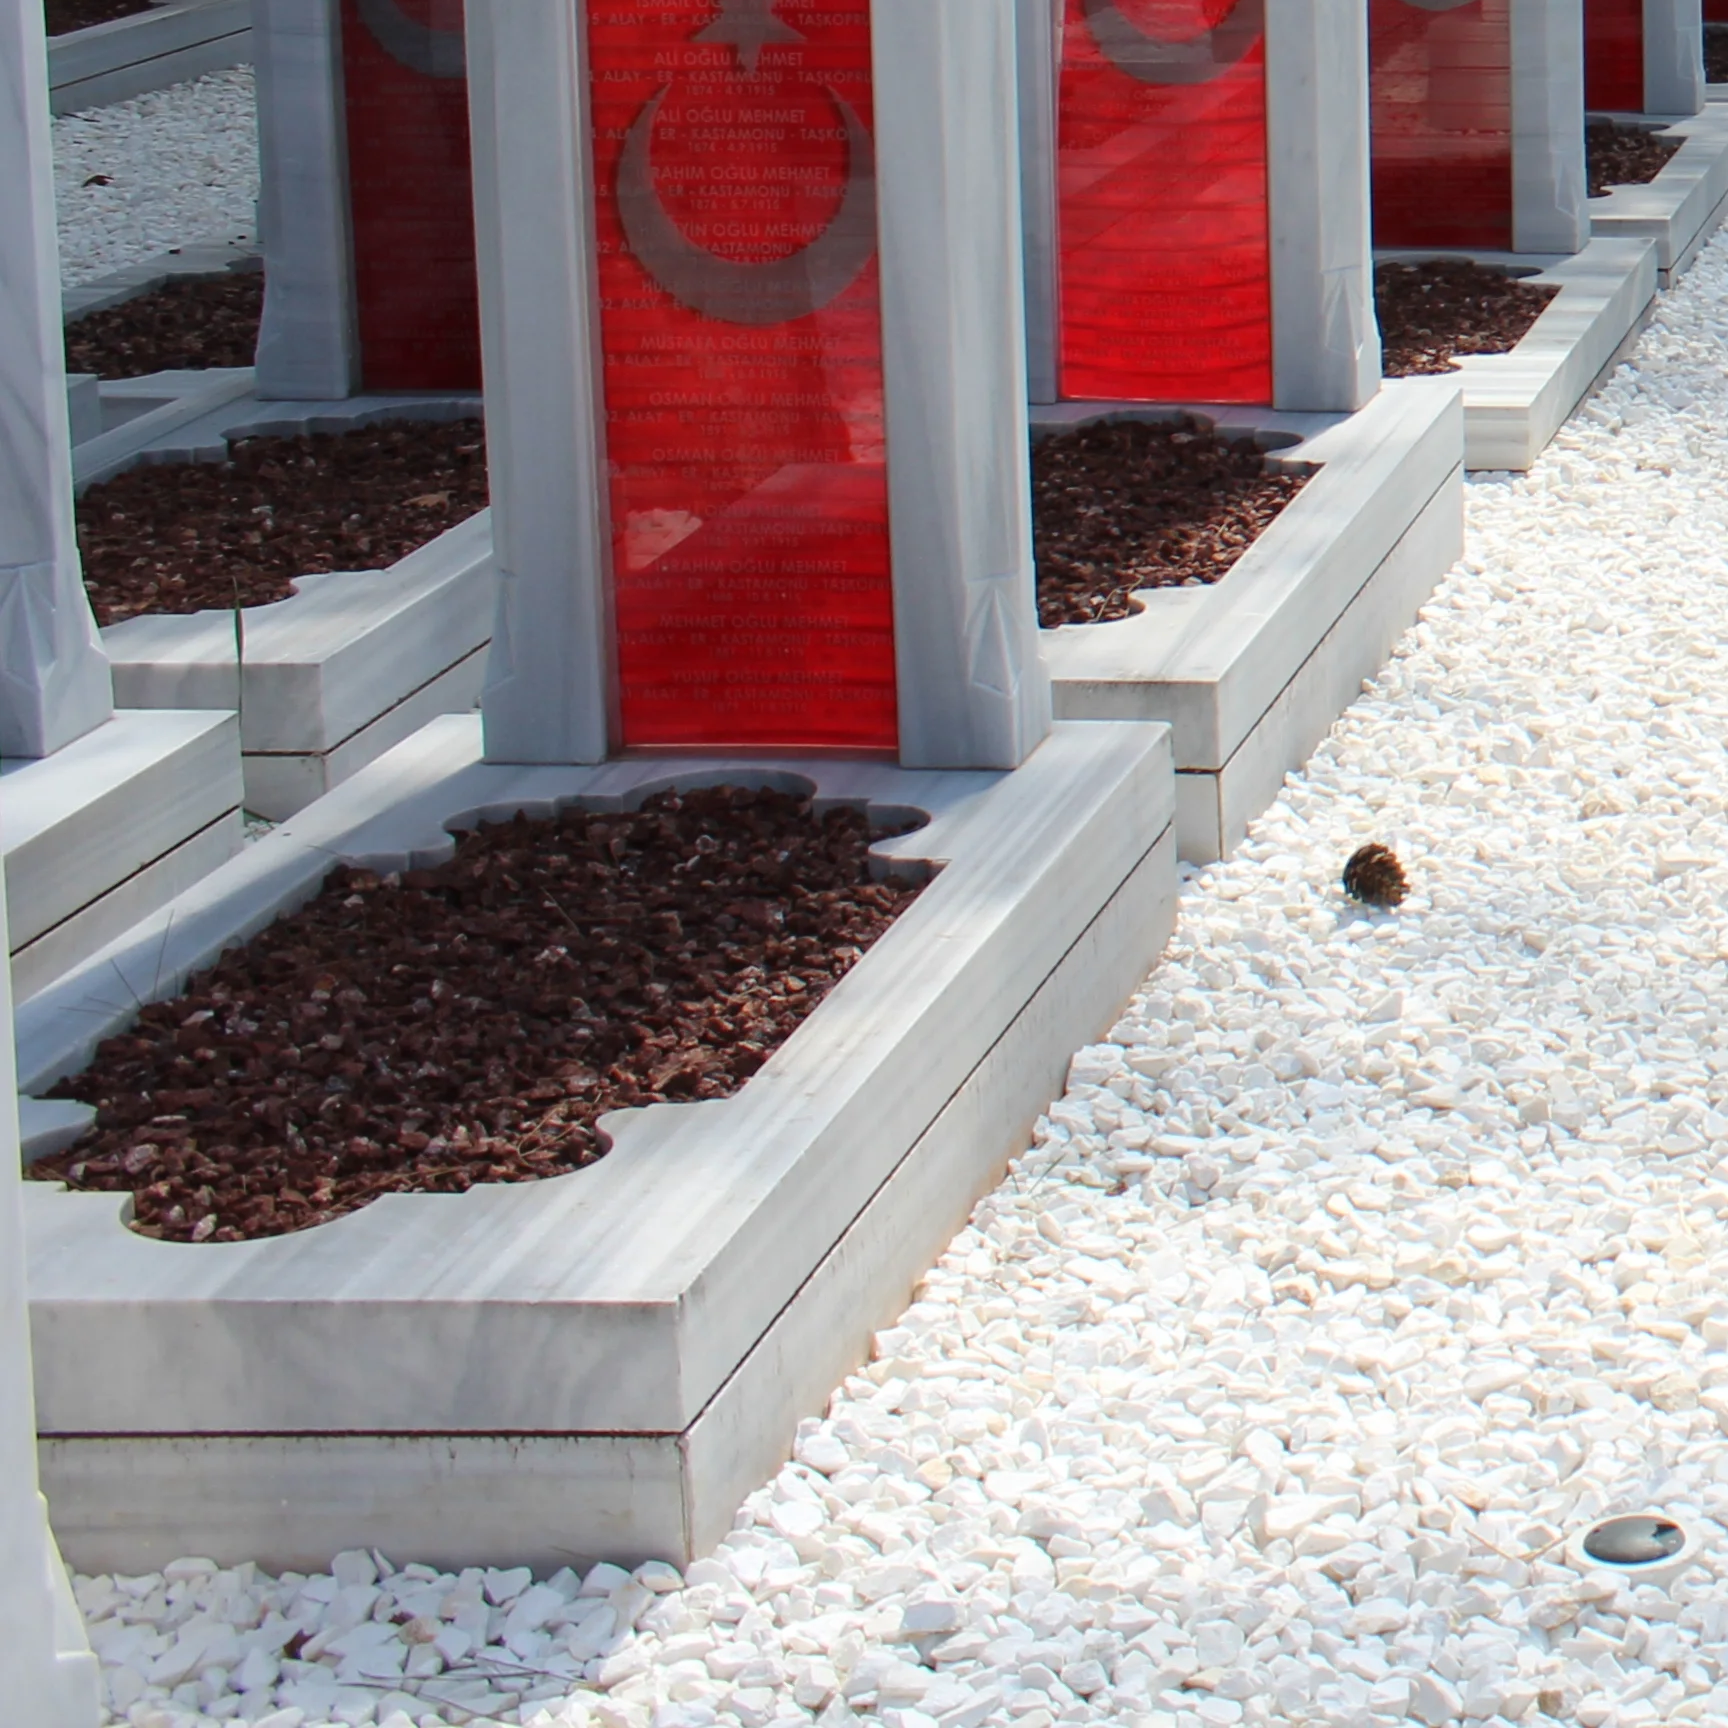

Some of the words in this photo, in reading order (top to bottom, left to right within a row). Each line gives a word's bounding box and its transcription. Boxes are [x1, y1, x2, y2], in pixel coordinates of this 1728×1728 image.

[609, 14, 645, 24] ALAY
[662, 14, 677, 24] ER
[654, 50, 678, 65] ALİ
[684, 49, 730, 66] OĞLU
[604, 71, 640, 82] ALAY
[658, 72, 673, 82] ER
[689, 71, 782, 83] KASTAMONU
[656, 109, 680, 122] ALİ
[686, 106, 733, 123] OĞLU
[738, 110, 806, 123] MEHMET
[660, 129, 676, 140] ER
[692, 128, 785, 140] KASTAMONU
[711, 164, 758, 180] OĞLU
[762, 166, 830, 180] MEHMET
[669, 186, 684, 196] ER
[700, 186, 790, 198] KASTAMONU
[713, 220, 760, 237] OĞLU
[622, 298, 658, 310] ALAY
[641, 336, 716, 350] MUSTAFA
[721, 332, 768, 350] OĞLU
[773, 336, 840, 350] MEHMET
[625, 355, 660, 366] ALAY
[706, 355, 798, 367] KASTAMONU
[649, 392, 712, 406] OSMAN
[627, 412, 664, 422] ALAY
[679, 412, 694, 422] ER
[710, 412, 800, 424] KASTAMONU
[652, 448, 714, 462] OSMAN
[773, 450, 838, 462] MEHMET
[705, 502, 751, 517] OĞLU
[756, 505, 824, 518] MEHMET
[716, 523, 805, 535] KASTAMONU
[730, 558, 776, 573] OĞLU
[781, 561, 848, 574] MEHMET
[718, 578, 808, 590] KASTAMONU
[660, 614, 726, 628] MEHMET
[732, 612, 777, 628] OĞLU
[783, 615, 850, 629] MEHMET
[639, 634, 676, 644] ALAY
[720, 634, 812, 646] KASTAMONU
[726, 666, 772, 684] OĞLU
[776, 670, 845, 684] MEHMET
[724, 688, 813, 701] KASTAMONU
